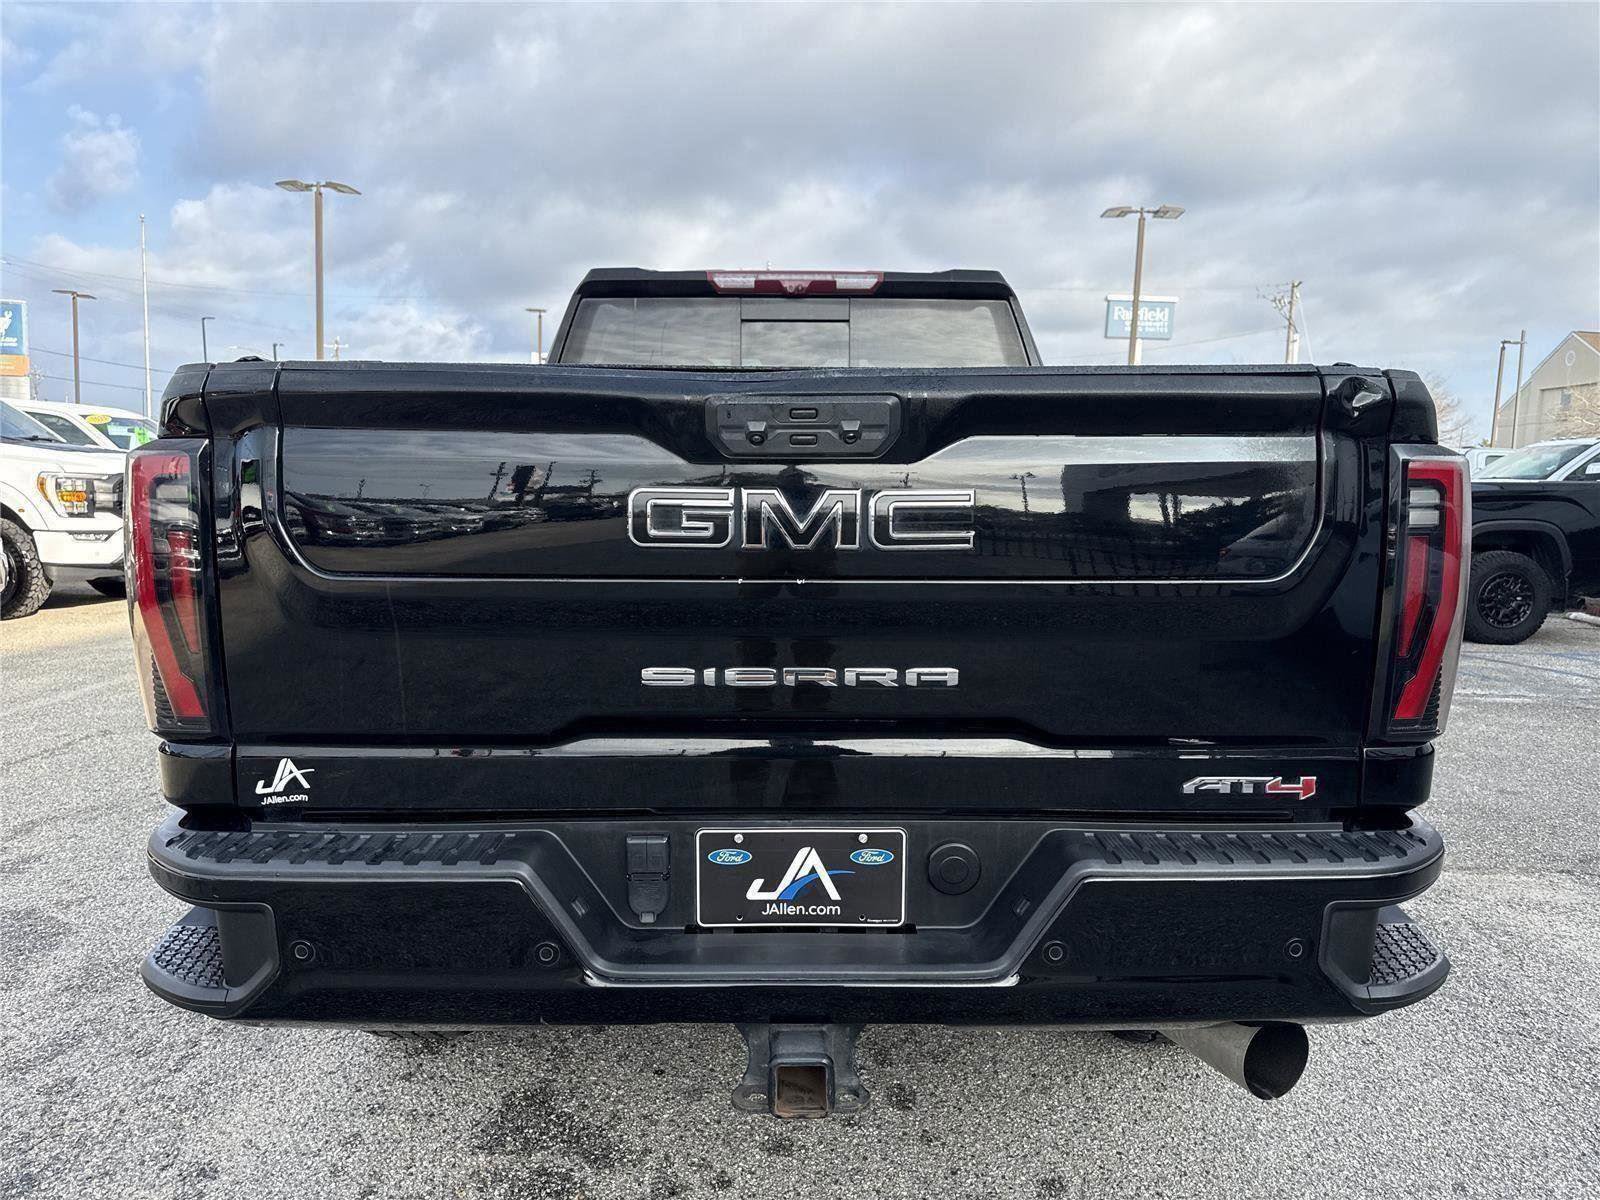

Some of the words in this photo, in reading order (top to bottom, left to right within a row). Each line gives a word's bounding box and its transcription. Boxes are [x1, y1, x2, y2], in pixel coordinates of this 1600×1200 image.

[628, 487, 976, 550] GMC
[641, 667, 959, 688] SIERRA
[1182, 776, 1317, 800] AT4
[260, 794, 309, 805] JAllen.com
[715, 849, 744, 863] Ford
[857, 849, 886, 863] Ford
[761, 902, 841, 916] JAllen.com
